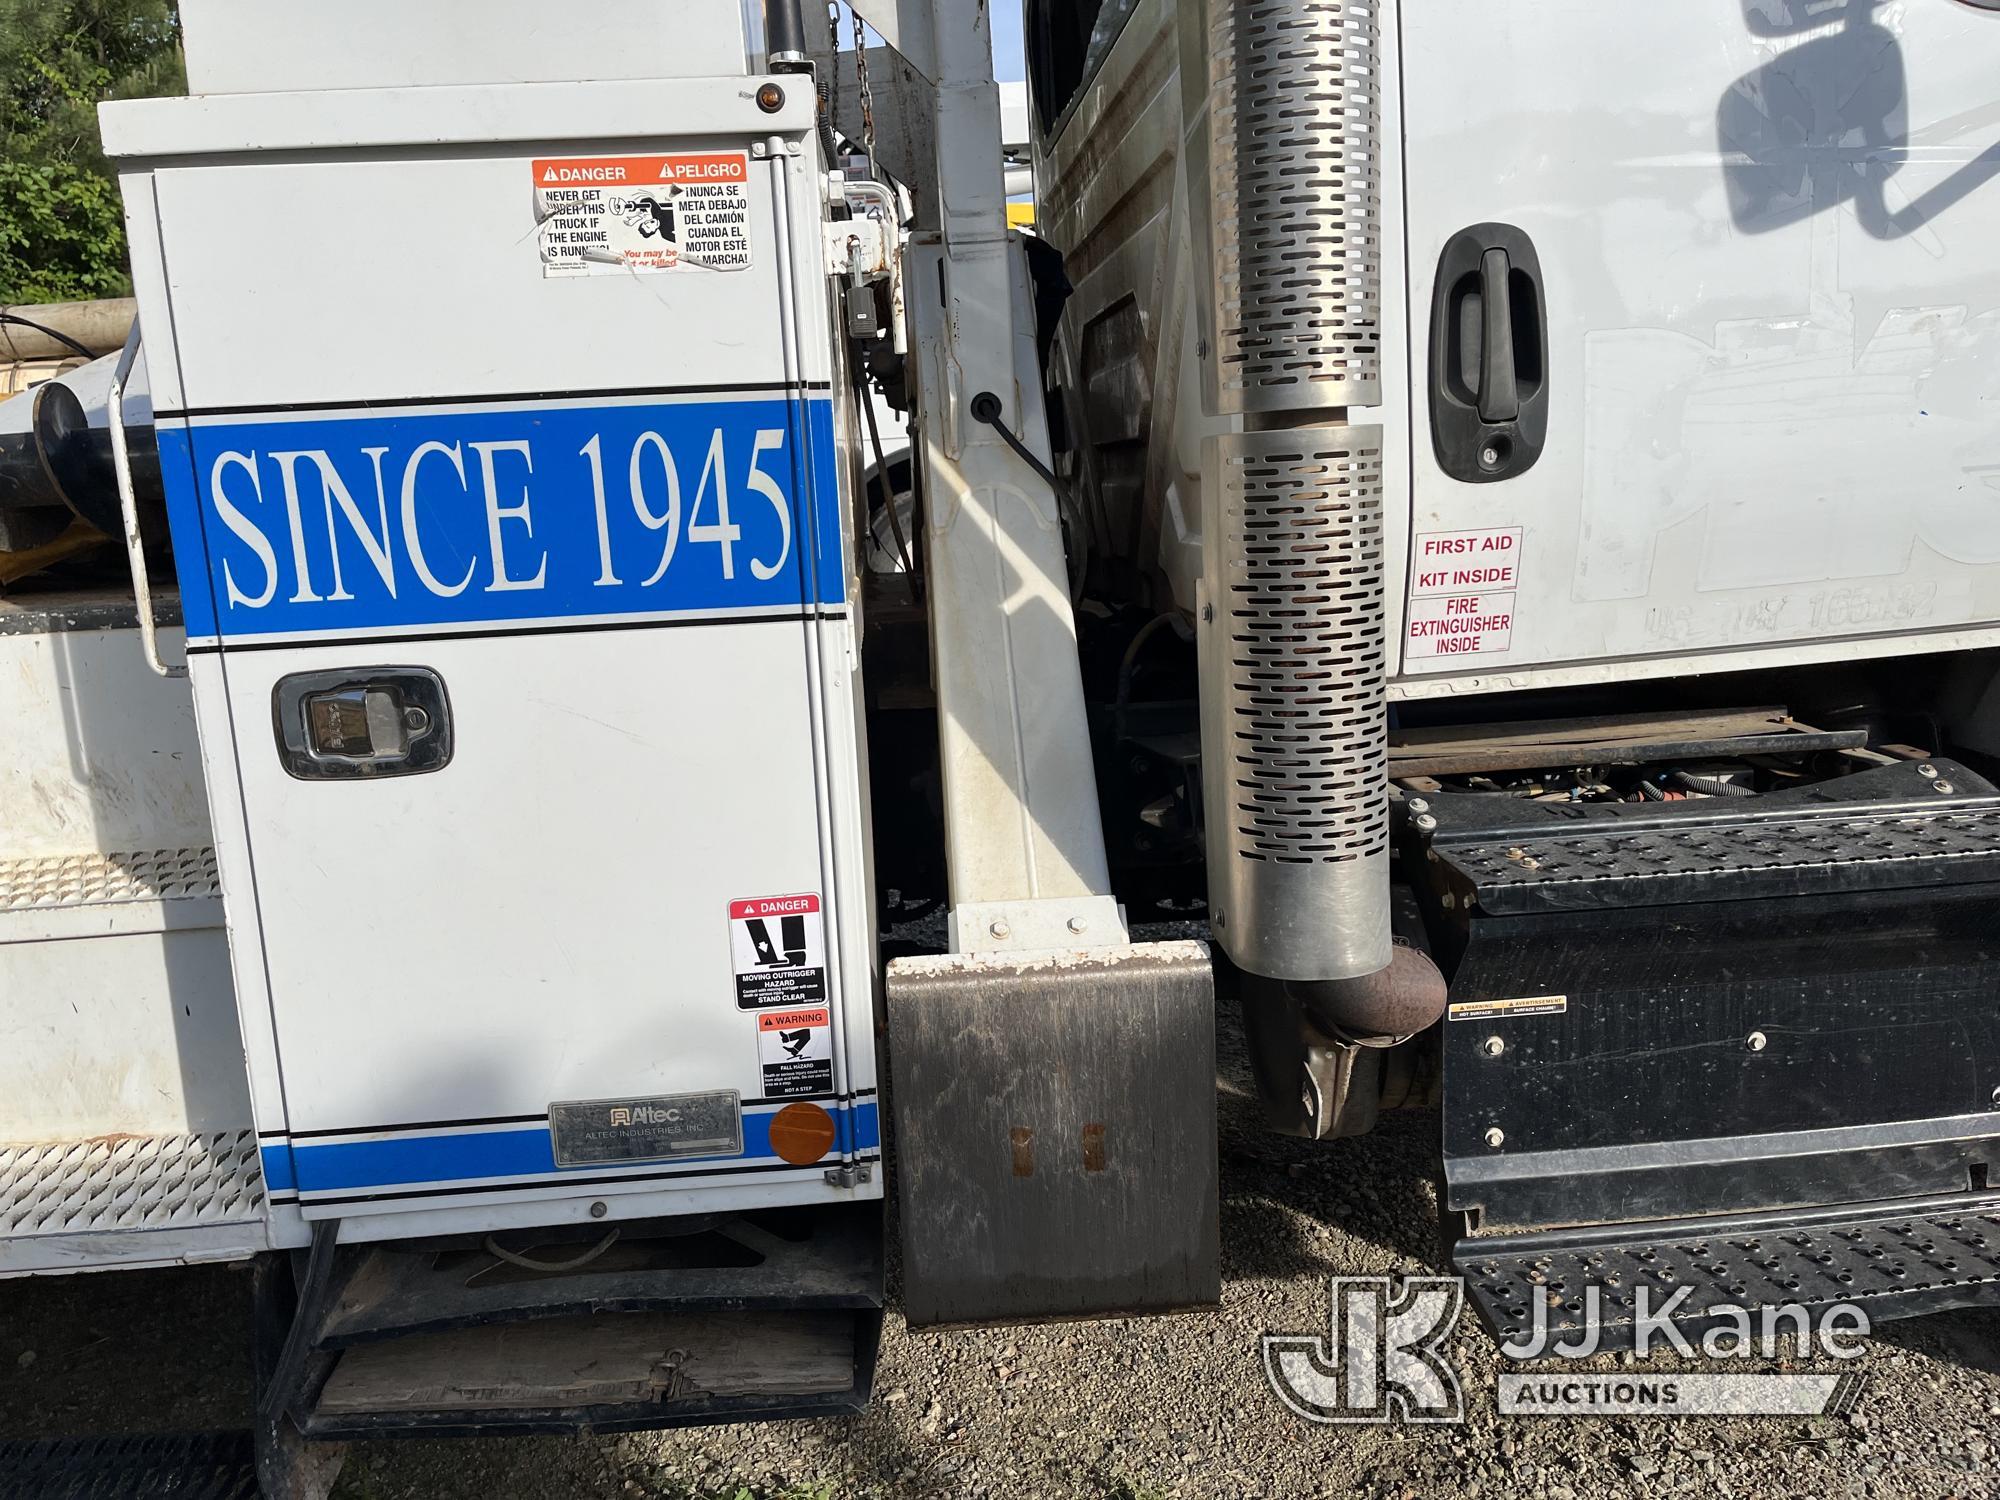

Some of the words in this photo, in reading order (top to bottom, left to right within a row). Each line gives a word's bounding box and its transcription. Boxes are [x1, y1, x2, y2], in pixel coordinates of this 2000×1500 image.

[559, 167, 626, 181] DANGER
[676, 163, 741, 178] PELIGRO
[546, 191, 578, 201] NEVER
[582, 190, 600, 200] GET
[726, 186, 738, 196] SE
[584, 204, 605, 214] THIS
[679, 200, 706, 211] META
[708, 199, 746, 210] DEBAJO
[553, 218, 587, 229] TRUCK
[590, 218, 599, 228] IF
[684, 214, 703, 224] DEL
[706, 211, 744, 224] CAMIÓN
[548, 233, 567, 243] THE
[570, 232, 607, 242] ENGINE
[688, 228, 728, 238] CUANDA
[731, 227, 742, 237] EL
[686, 241, 720, 252] MOTOR
[724, 238, 747, 250] ESTÉ
[548, 247, 557, 256] IS
[644, 250, 663, 258] may
[702, 254, 748, 264] MARCHA!
[211, 440, 547, 610] SINCE
[580, 427, 791, 587] 1945
[1425, 538, 1478, 555] FIRST
[1482, 536, 1512, 551] AID
[1420, 572, 1448, 587] KIT
[1453, 568, 1512, 584] INSIDE
[1447, 598, 1478, 615] FIRE
[1410, 614, 1510, 637] EXTINGUISHER
[1436, 636, 1480, 654] INSIDE
[760, 900, 808, 912] DANGER
[742, 974, 771, 982] MOVING
[772, 970, 816, 978] OUTRIGGER
[764, 980, 794, 988] HAZARD
[776, 1014, 822, 1024] WARNING
[585, 1131, 616, 1140] ALTEC
